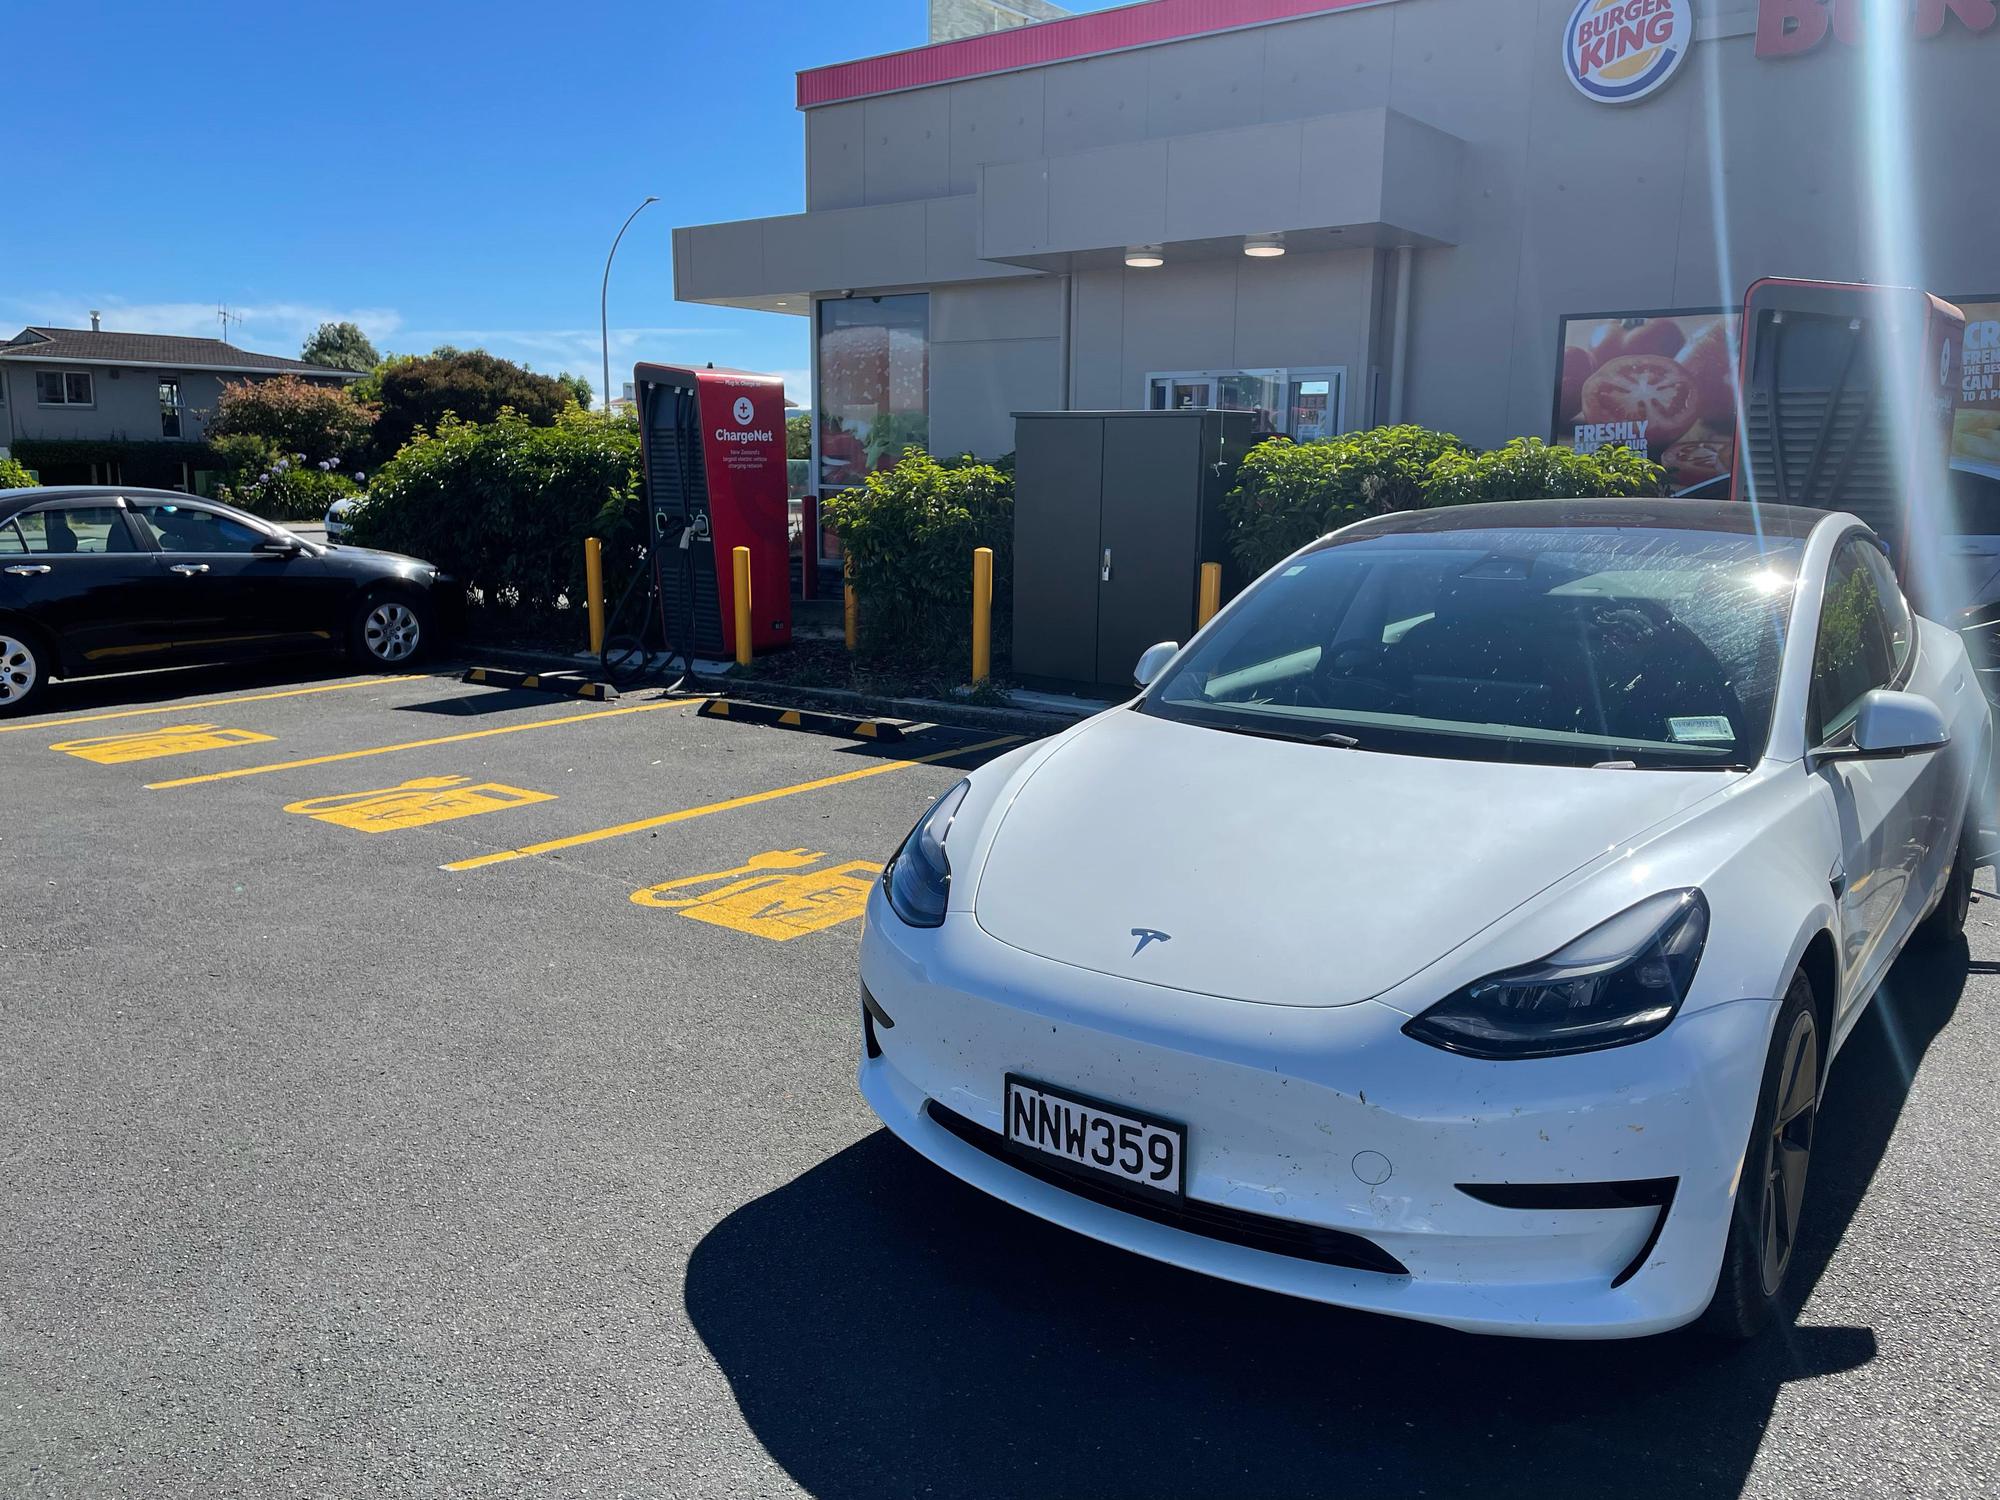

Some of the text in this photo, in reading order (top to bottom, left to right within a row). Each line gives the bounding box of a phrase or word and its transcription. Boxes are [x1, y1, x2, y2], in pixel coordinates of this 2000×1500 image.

[1580, 11, 1675, 77] KING
[1963, 365, 1981, 375] THE
[1962, 375, 1993, 391] CAN
[1963, 391, 1976, 402] TO
[1979, 390, 1987, 401] A
[715, 428, 773, 444] ChargeNet
[1574, 420, 1648, 442] FRESHLY
[1014, 1091, 1174, 1181] NNW359
